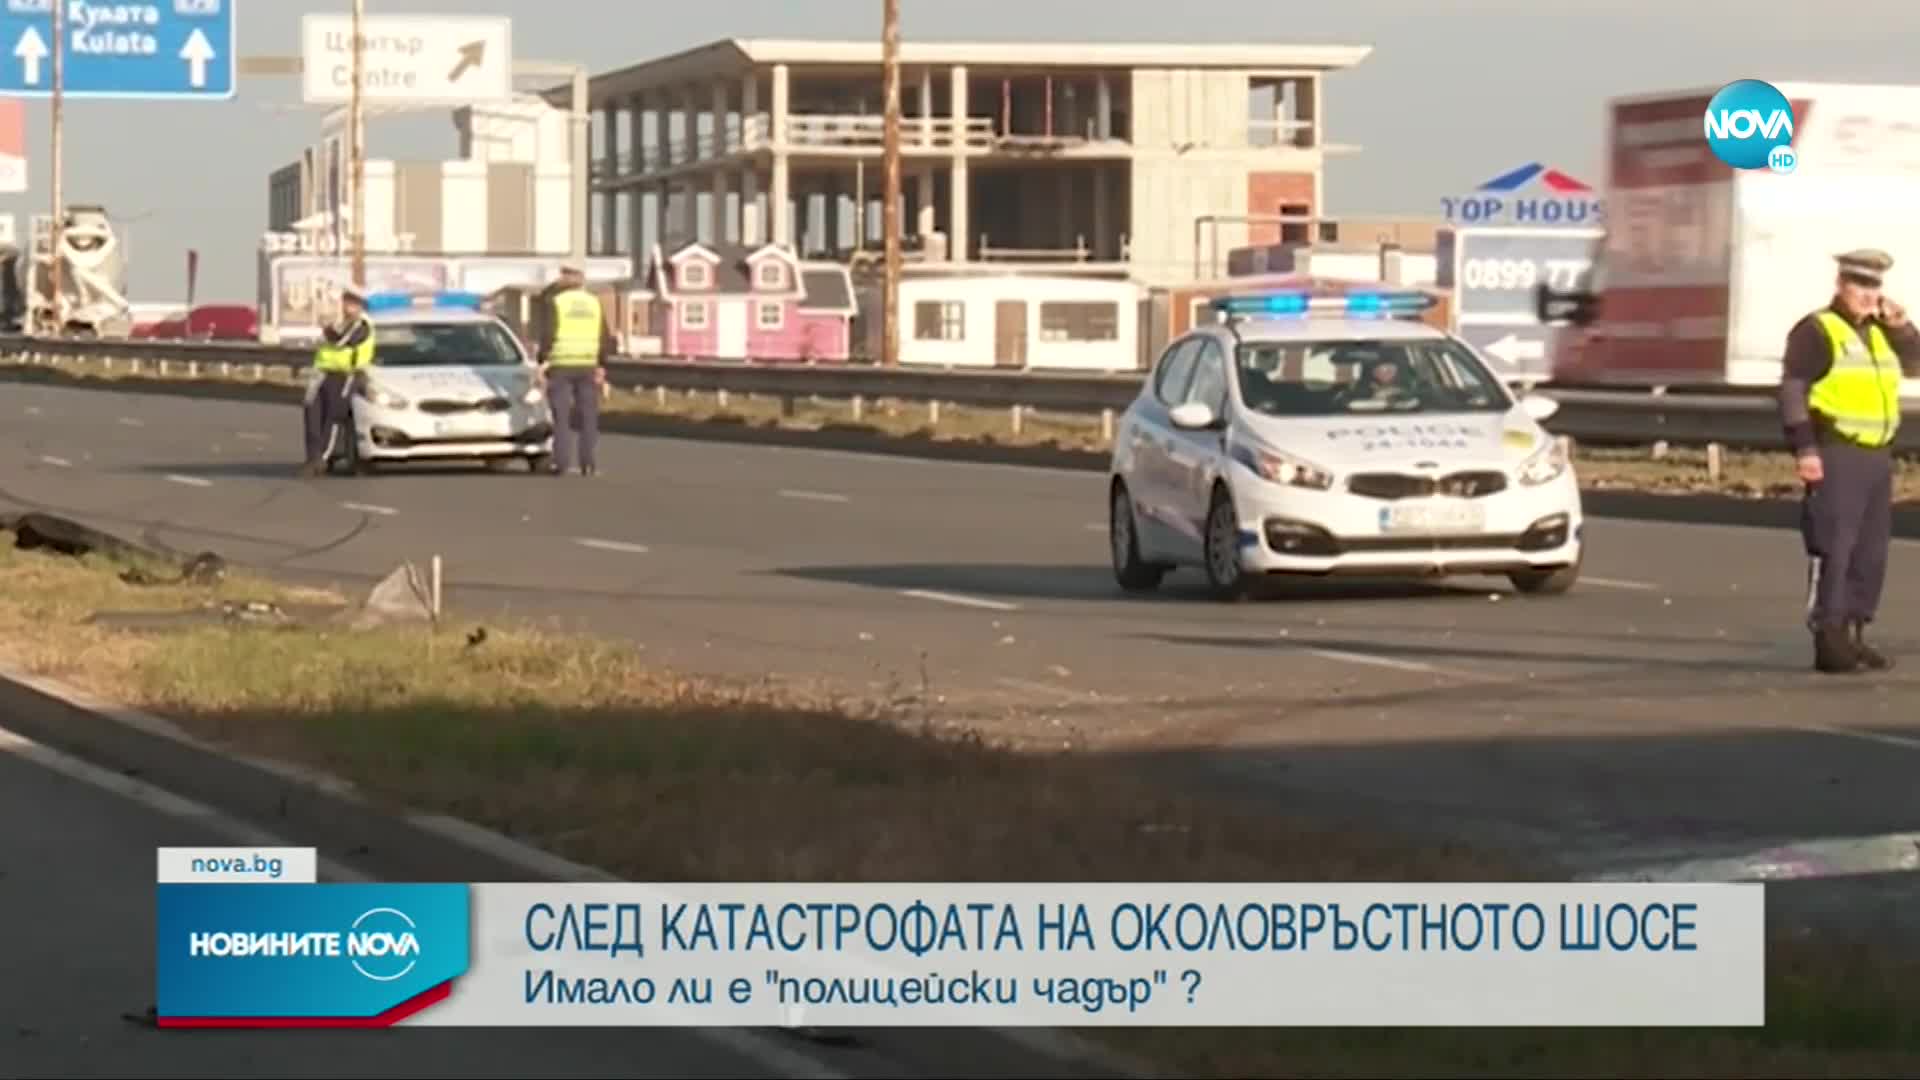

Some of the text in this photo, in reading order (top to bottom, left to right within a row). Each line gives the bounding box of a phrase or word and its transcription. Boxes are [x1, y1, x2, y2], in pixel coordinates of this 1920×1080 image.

[68, 1, 160, 33] Кулата
[71, 30, 157, 54] Kulata
[331, 63, 417, 88] Cntre
[1441, 197, 1503, 222] TOP
[1465, 258, 1538, 290] 0899
